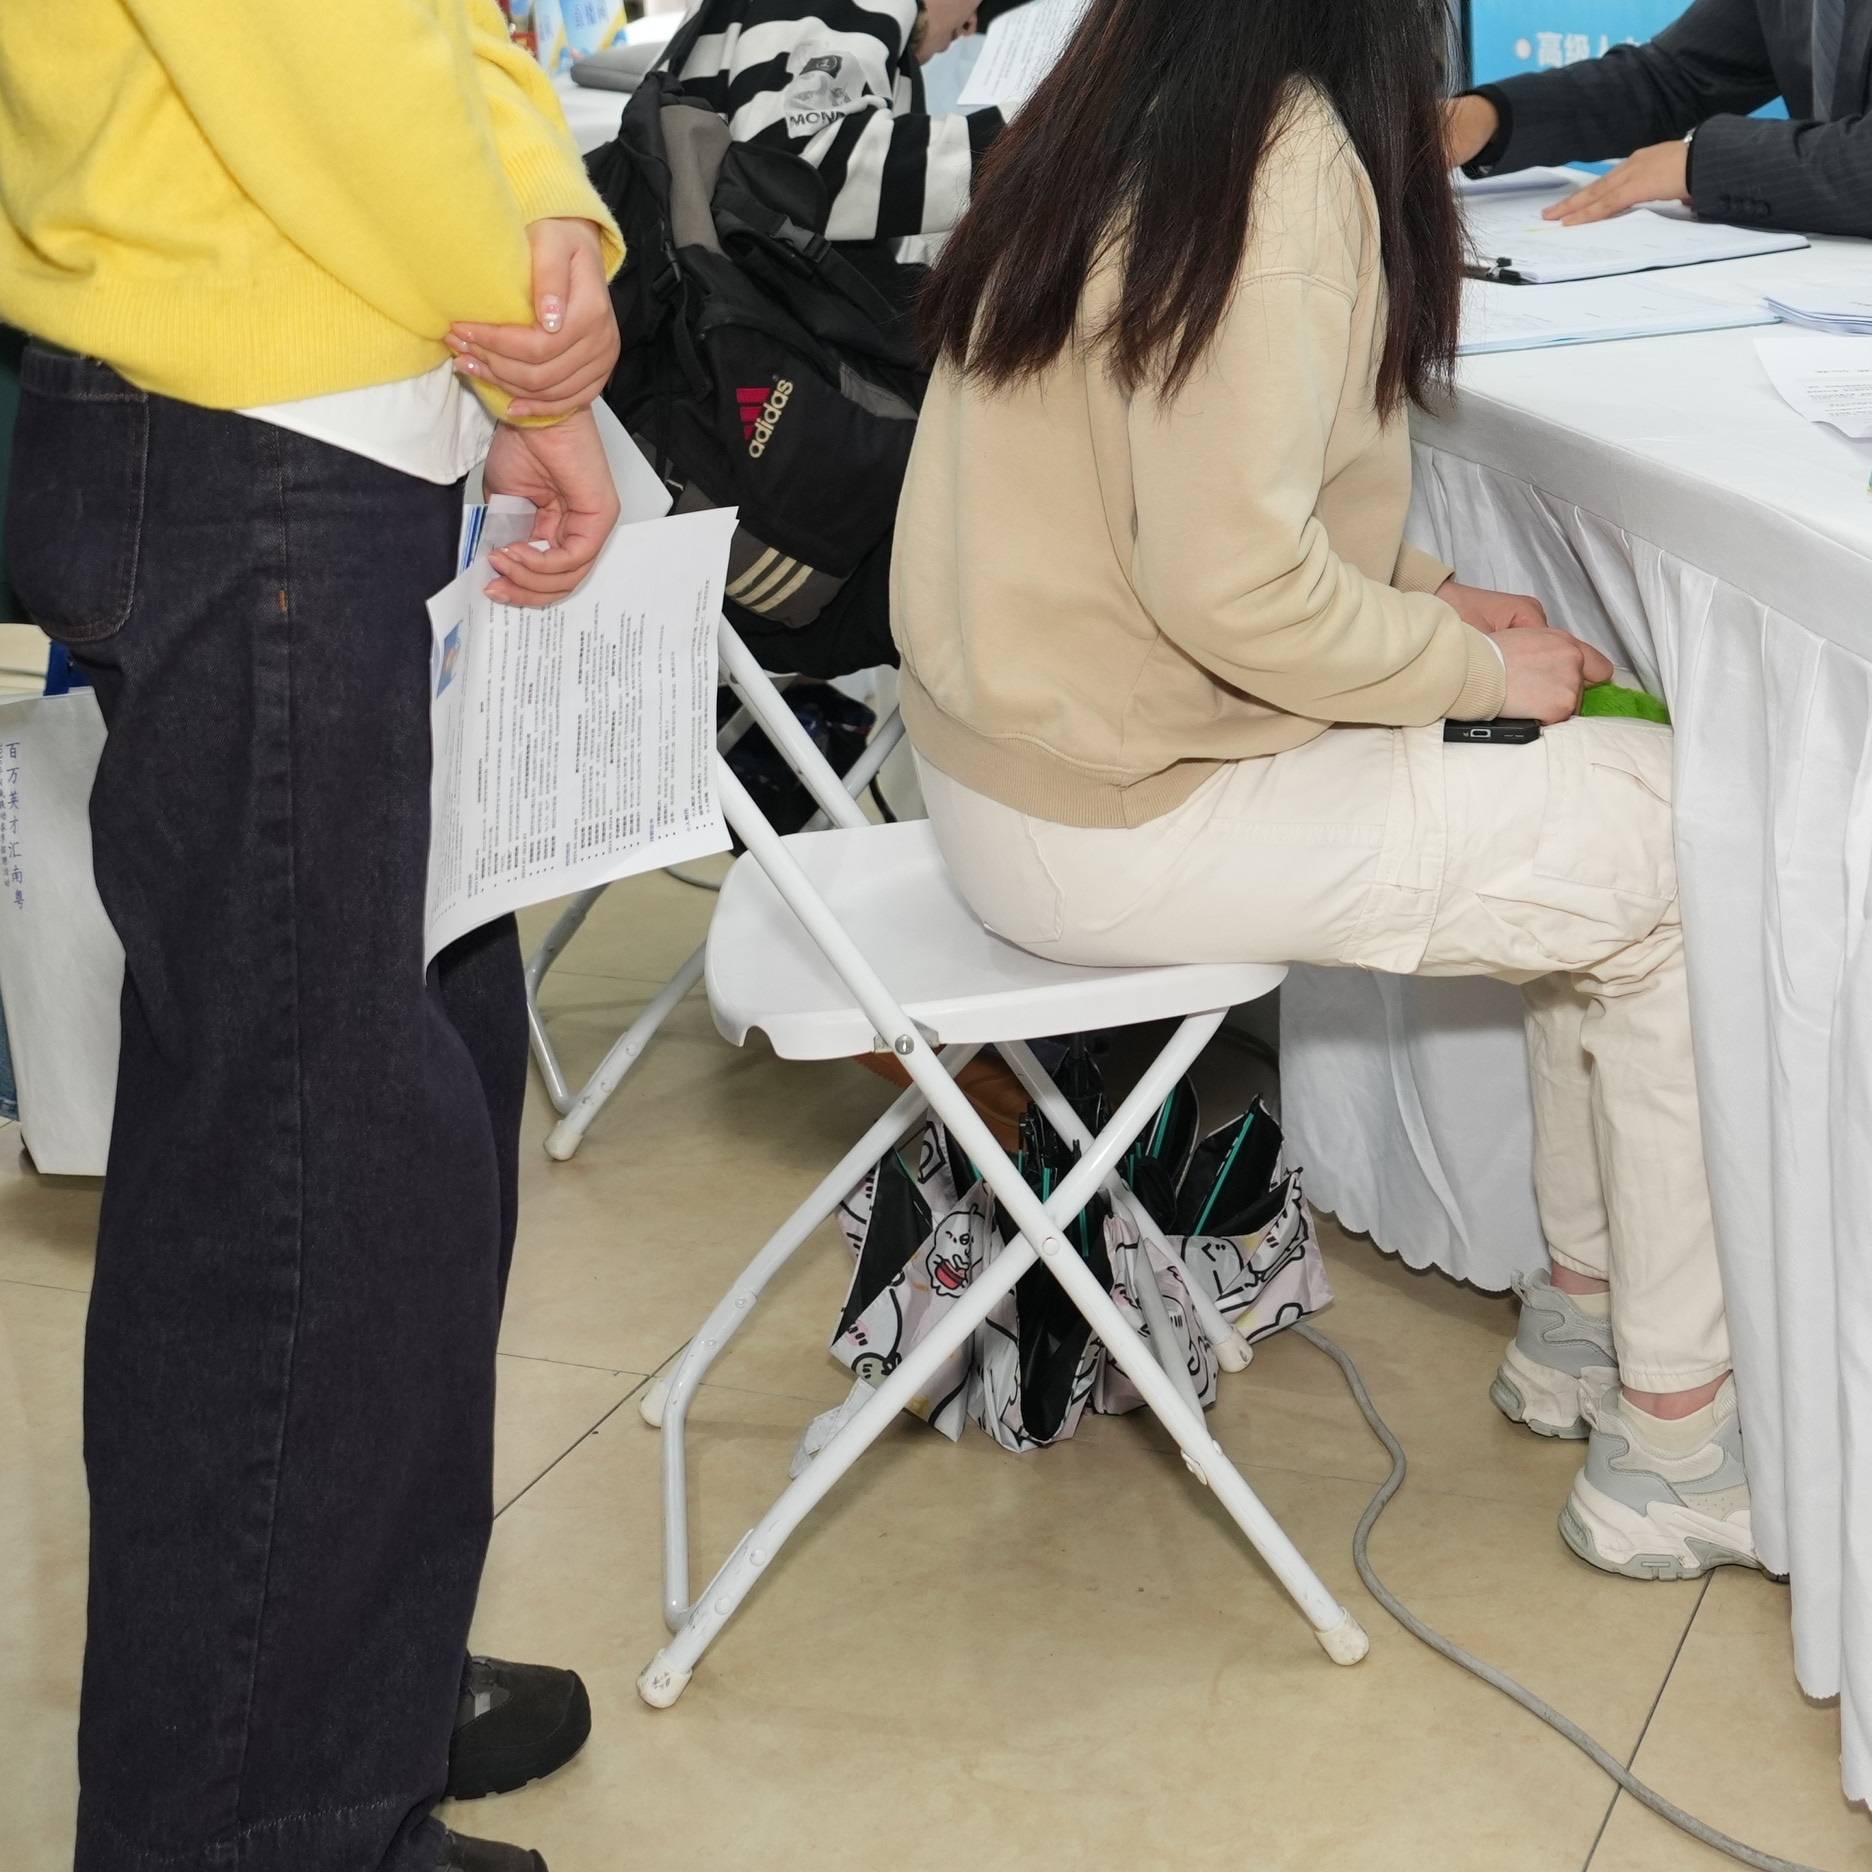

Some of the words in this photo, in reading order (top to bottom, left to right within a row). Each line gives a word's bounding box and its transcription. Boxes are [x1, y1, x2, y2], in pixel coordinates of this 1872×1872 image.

[748, 378, 794, 459] adidas
[5, 741, 26, 911] 百万英才汇南粤
